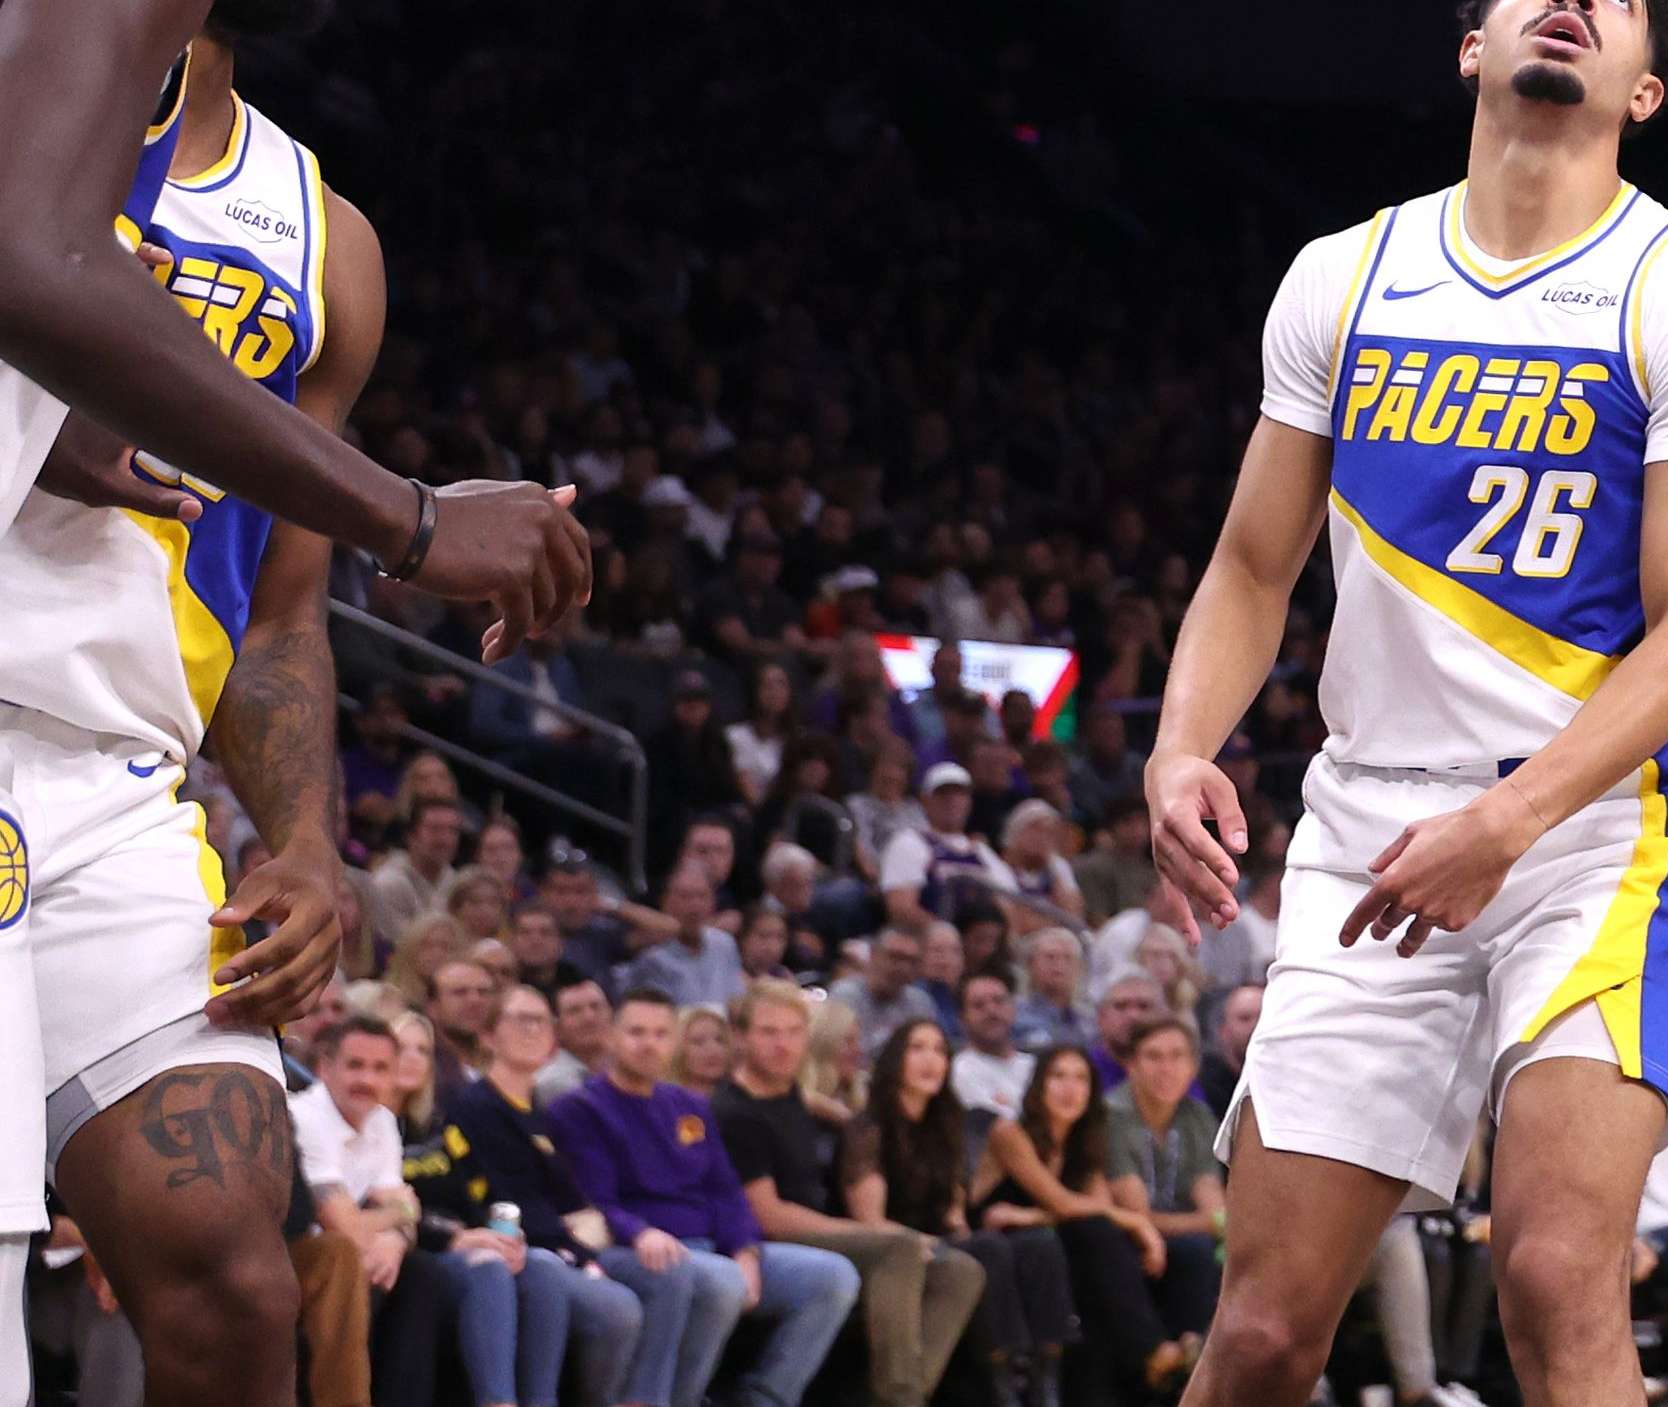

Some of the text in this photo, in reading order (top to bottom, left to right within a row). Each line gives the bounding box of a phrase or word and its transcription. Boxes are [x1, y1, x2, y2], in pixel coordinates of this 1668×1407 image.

[225, 203, 298, 240] LUCAS OIL
[1541, 288, 1618, 308] LUCAS OIL
[1342, 349, 1609, 455] PACERS
[1446, 465, 1597, 578] 26
